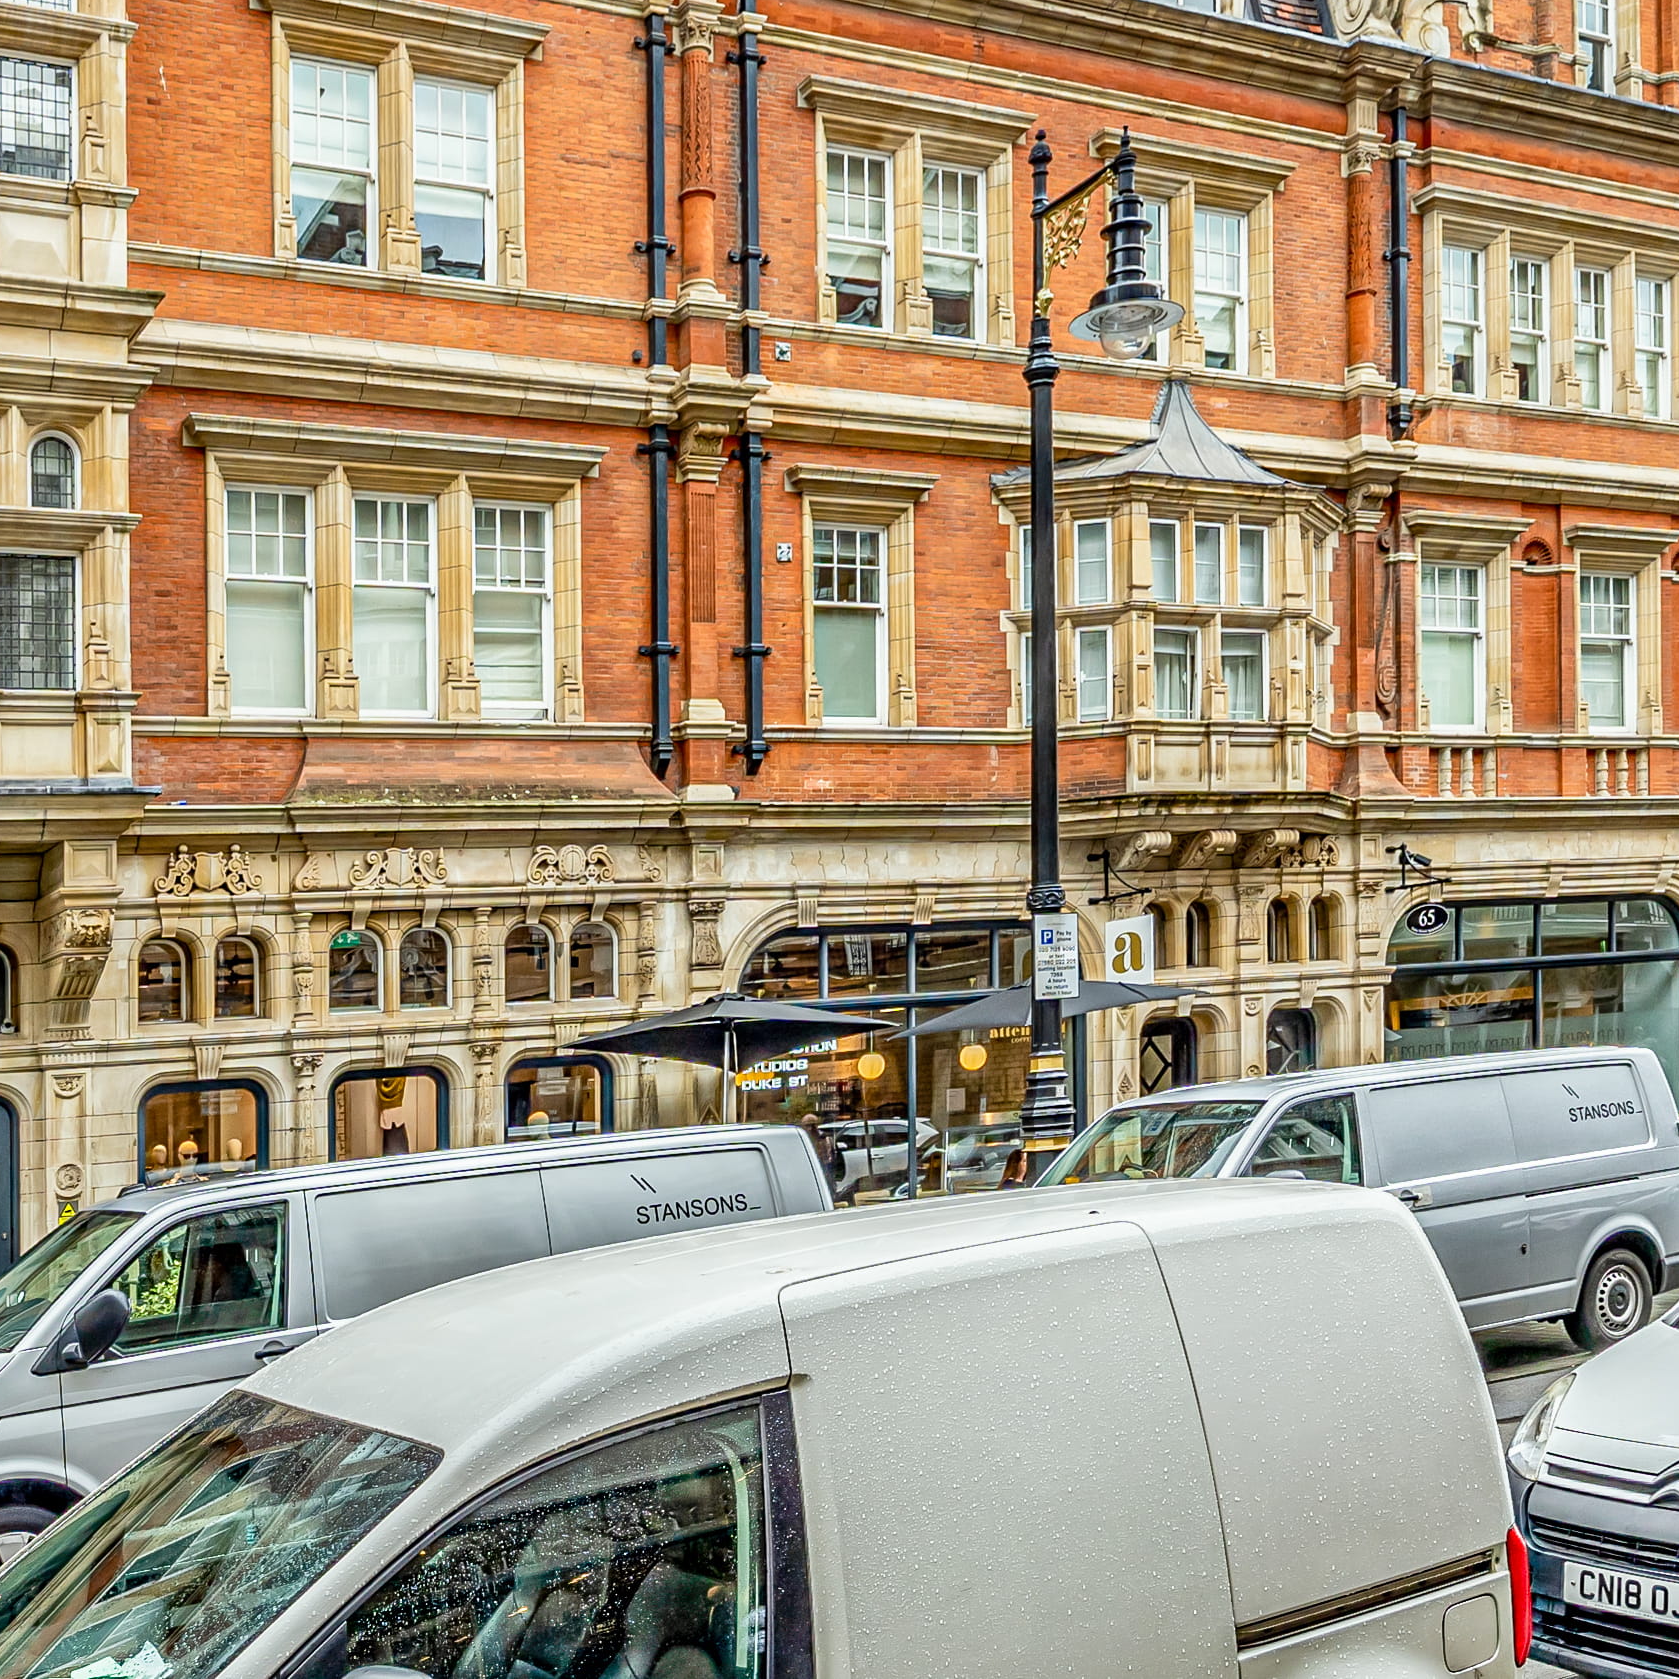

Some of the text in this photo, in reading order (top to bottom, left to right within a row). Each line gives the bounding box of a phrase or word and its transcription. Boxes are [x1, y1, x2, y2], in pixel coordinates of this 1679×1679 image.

[1419, 908, 1435, 927] 65
[1044, 931, 1052, 943] P
[1112, 931, 1145, 974] a
[742, 1075, 809, 1091] DUKE ST
[1579, 1570, 1642, 1610] CN18
